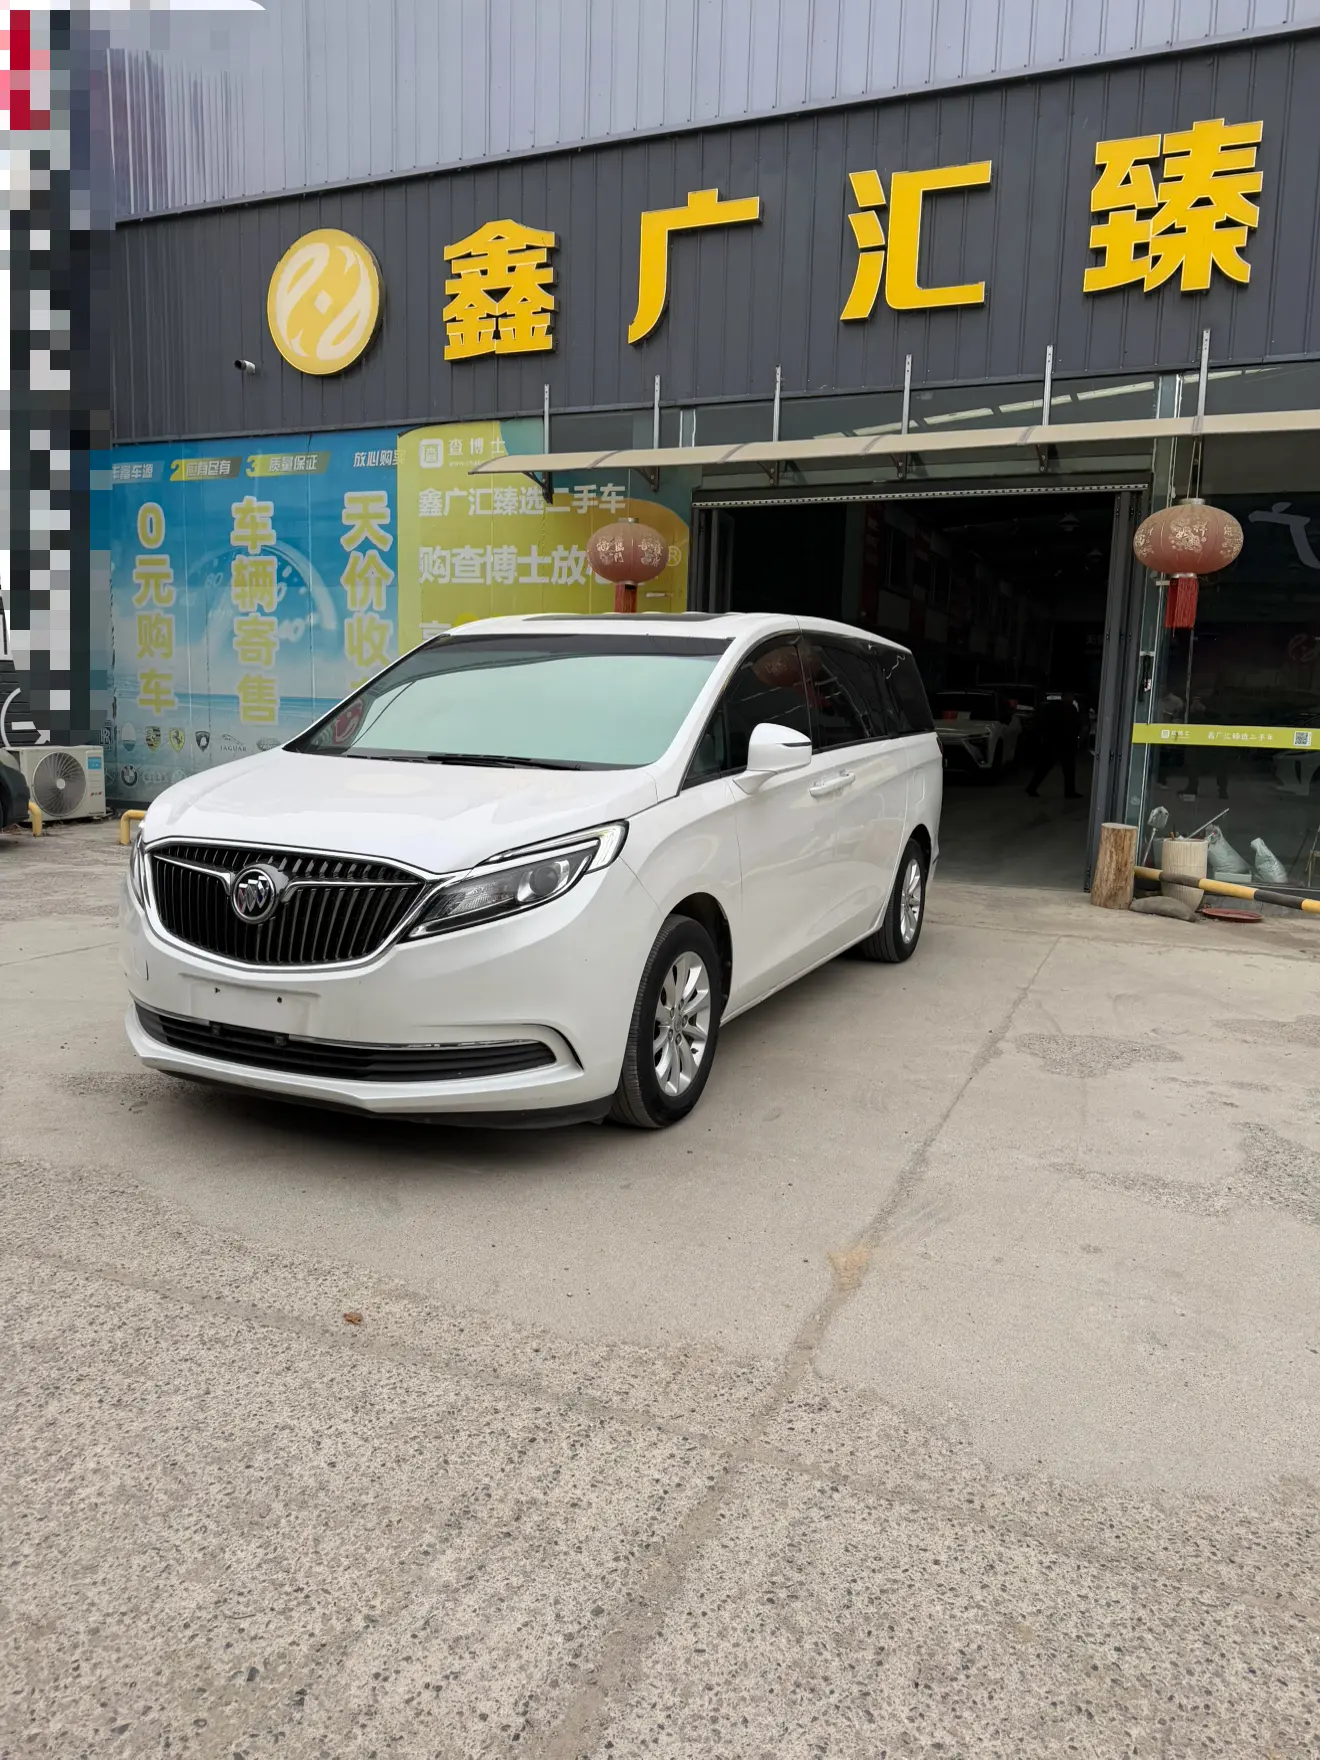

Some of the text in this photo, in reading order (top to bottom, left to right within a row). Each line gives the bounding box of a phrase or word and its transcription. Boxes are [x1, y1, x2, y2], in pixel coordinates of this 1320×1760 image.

[443, 118, 1265, 361] 鑫广汇臻
[269, 453, 318, 472] 质量保证
[353, 450, 405, 468] 放心购买
[418, 482, 626, 518] 鑫广汇臻选二手车
[448, 437, 506, 456] 查博士
[133, 501, 178, 717] 0元购车
[230, 495, 280, 727] 车辆寄售
[340, 490, 394, 692] 天价收
